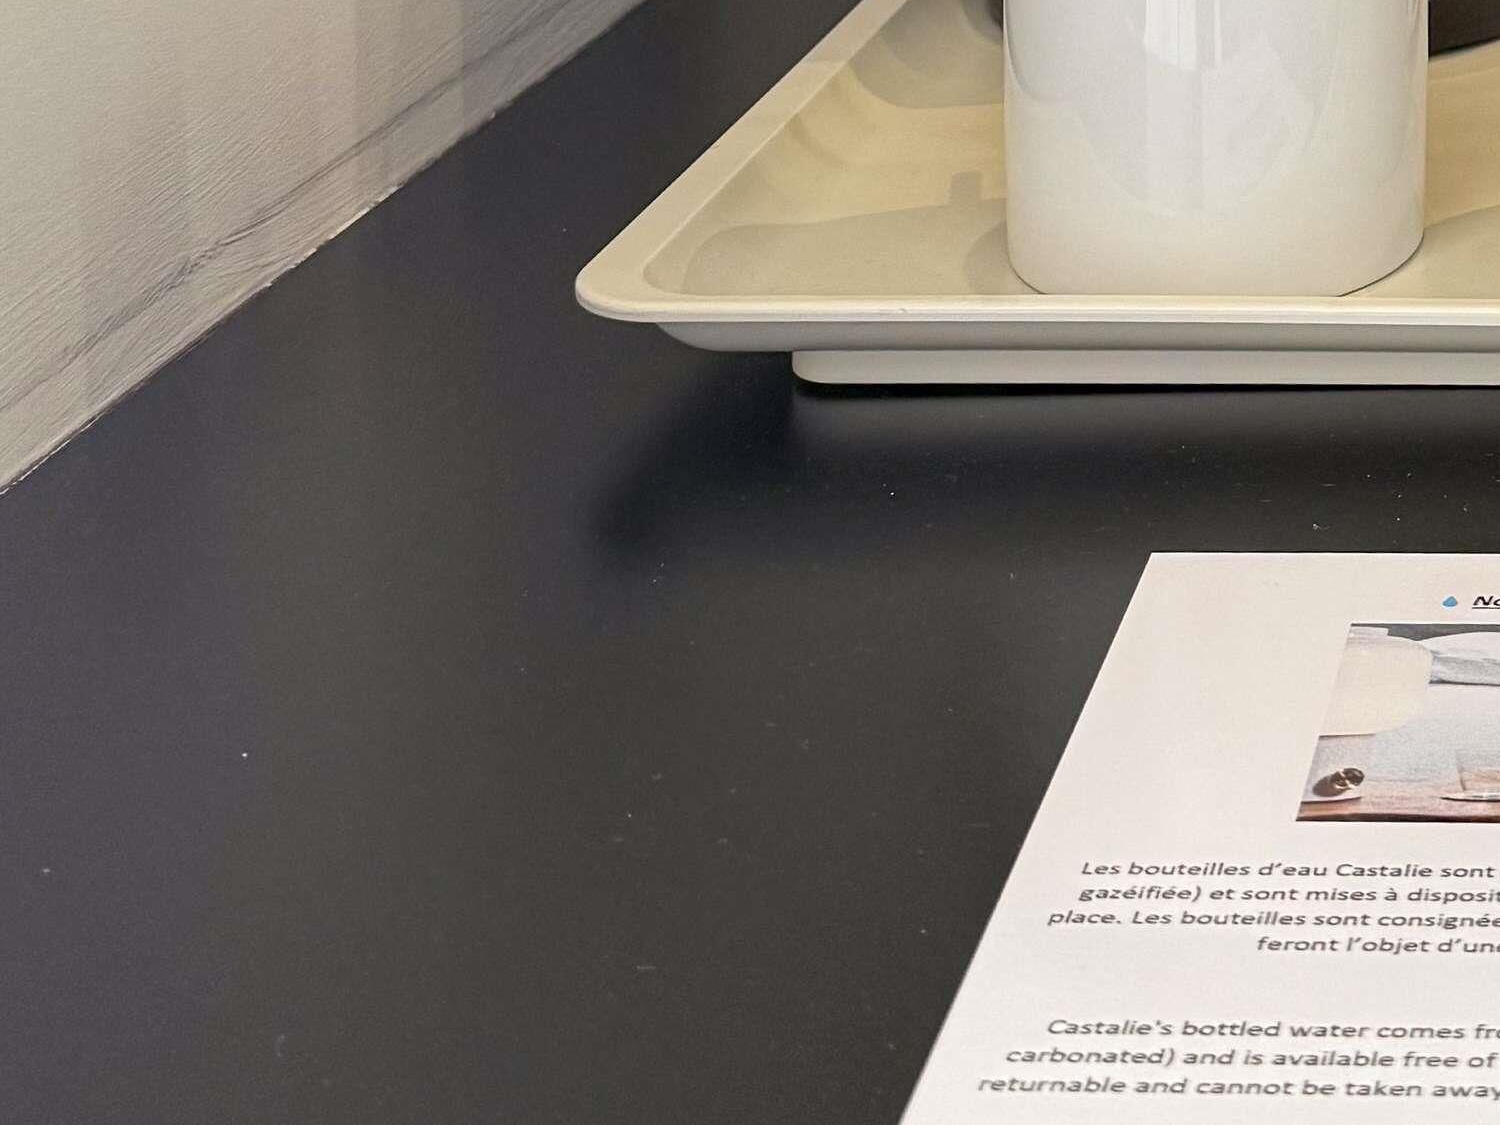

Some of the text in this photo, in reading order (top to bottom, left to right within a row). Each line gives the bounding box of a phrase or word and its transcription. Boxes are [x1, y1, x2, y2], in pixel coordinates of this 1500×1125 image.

[1081, 862, 1121, 877] Les
[1127, 861, 1251, 877] bouteilles
[1257, 861, 1328, 877] d’eau
[1335, 862, 1434, 879] Castalie
[1440, 866, 1496, 879] sont
[1077, 883, 1202, 905] gazéifiée)
[1208, 888, 1236, 901] et
[1240, 887, 1299, 902] sont
[1305, 887, 1377, 902] mises
[1383, 887, 1398, 902] à
[1046, 909, 1122, 928] place.
[1131, 910, 1173, 926] Les
[1180, 910, 1307, 926] bouteilles
[1312, 914, 1372, 927] sont
[1257, 936, 1340, 952] feront
[1346, 935, 1431, 956] l’objet
[1047, 1018, 1173, 1037] Castalie's
[1181, 1019, 1282, 1037] bottled
[1289, 1025, 1370, 1039] water
[1376, 1026, 1465, 1040] comes
[1005, 1045, 1176, 1067] carbonated)
[1182, 1048, 1236, 1066] and
[1243, 1049, 1264, 1067] is
[1271, 1049, 1395, 1068] available
[1403, 1050, 1459, 1068] free
[1467, 1051, 1499, 1070] of
[978, 1074, 1127, 1094] returnable
[1133, 1077, 1189, 1095] and
[1195, 1081, 1295, 1096] cannot
[1301, 1079, 1337, 1096] be
[1345, 1079, 1422, 1098] taken
